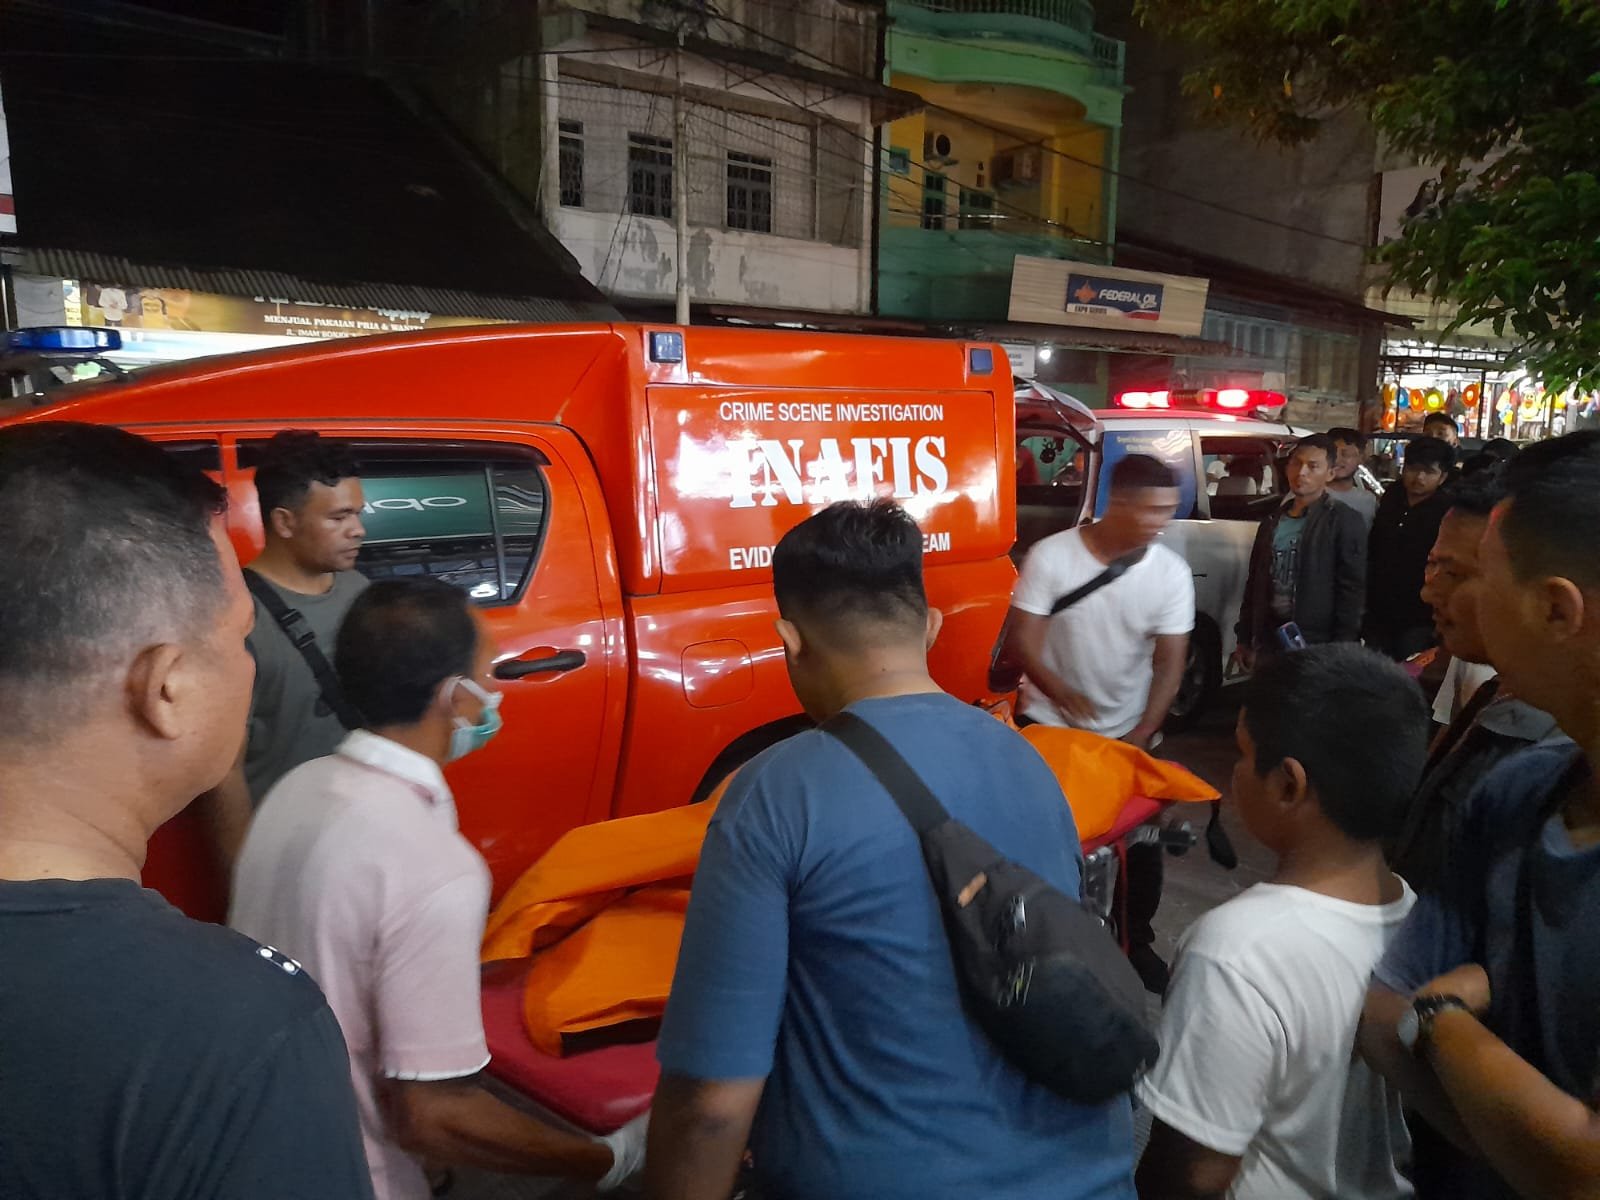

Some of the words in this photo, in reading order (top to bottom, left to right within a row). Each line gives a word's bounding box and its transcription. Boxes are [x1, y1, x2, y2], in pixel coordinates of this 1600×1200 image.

[1098, 288, 1142, 303] FEDERAL
[1142, 293, 1157, 305] OIL
[264, 315, 312, 325] MENJUAL
[314, 318, 355, 328] PAKAIAN
[357, 321, 379, 330] PRIA
[719, 402, 774, 421] CRIME
[779, 403, 832, 422] SCENE
[836, 404, 944, 422] INVESTIGATION
[729, 546, 777, 570] EVID
[922, 532, 951, 553] EAM
